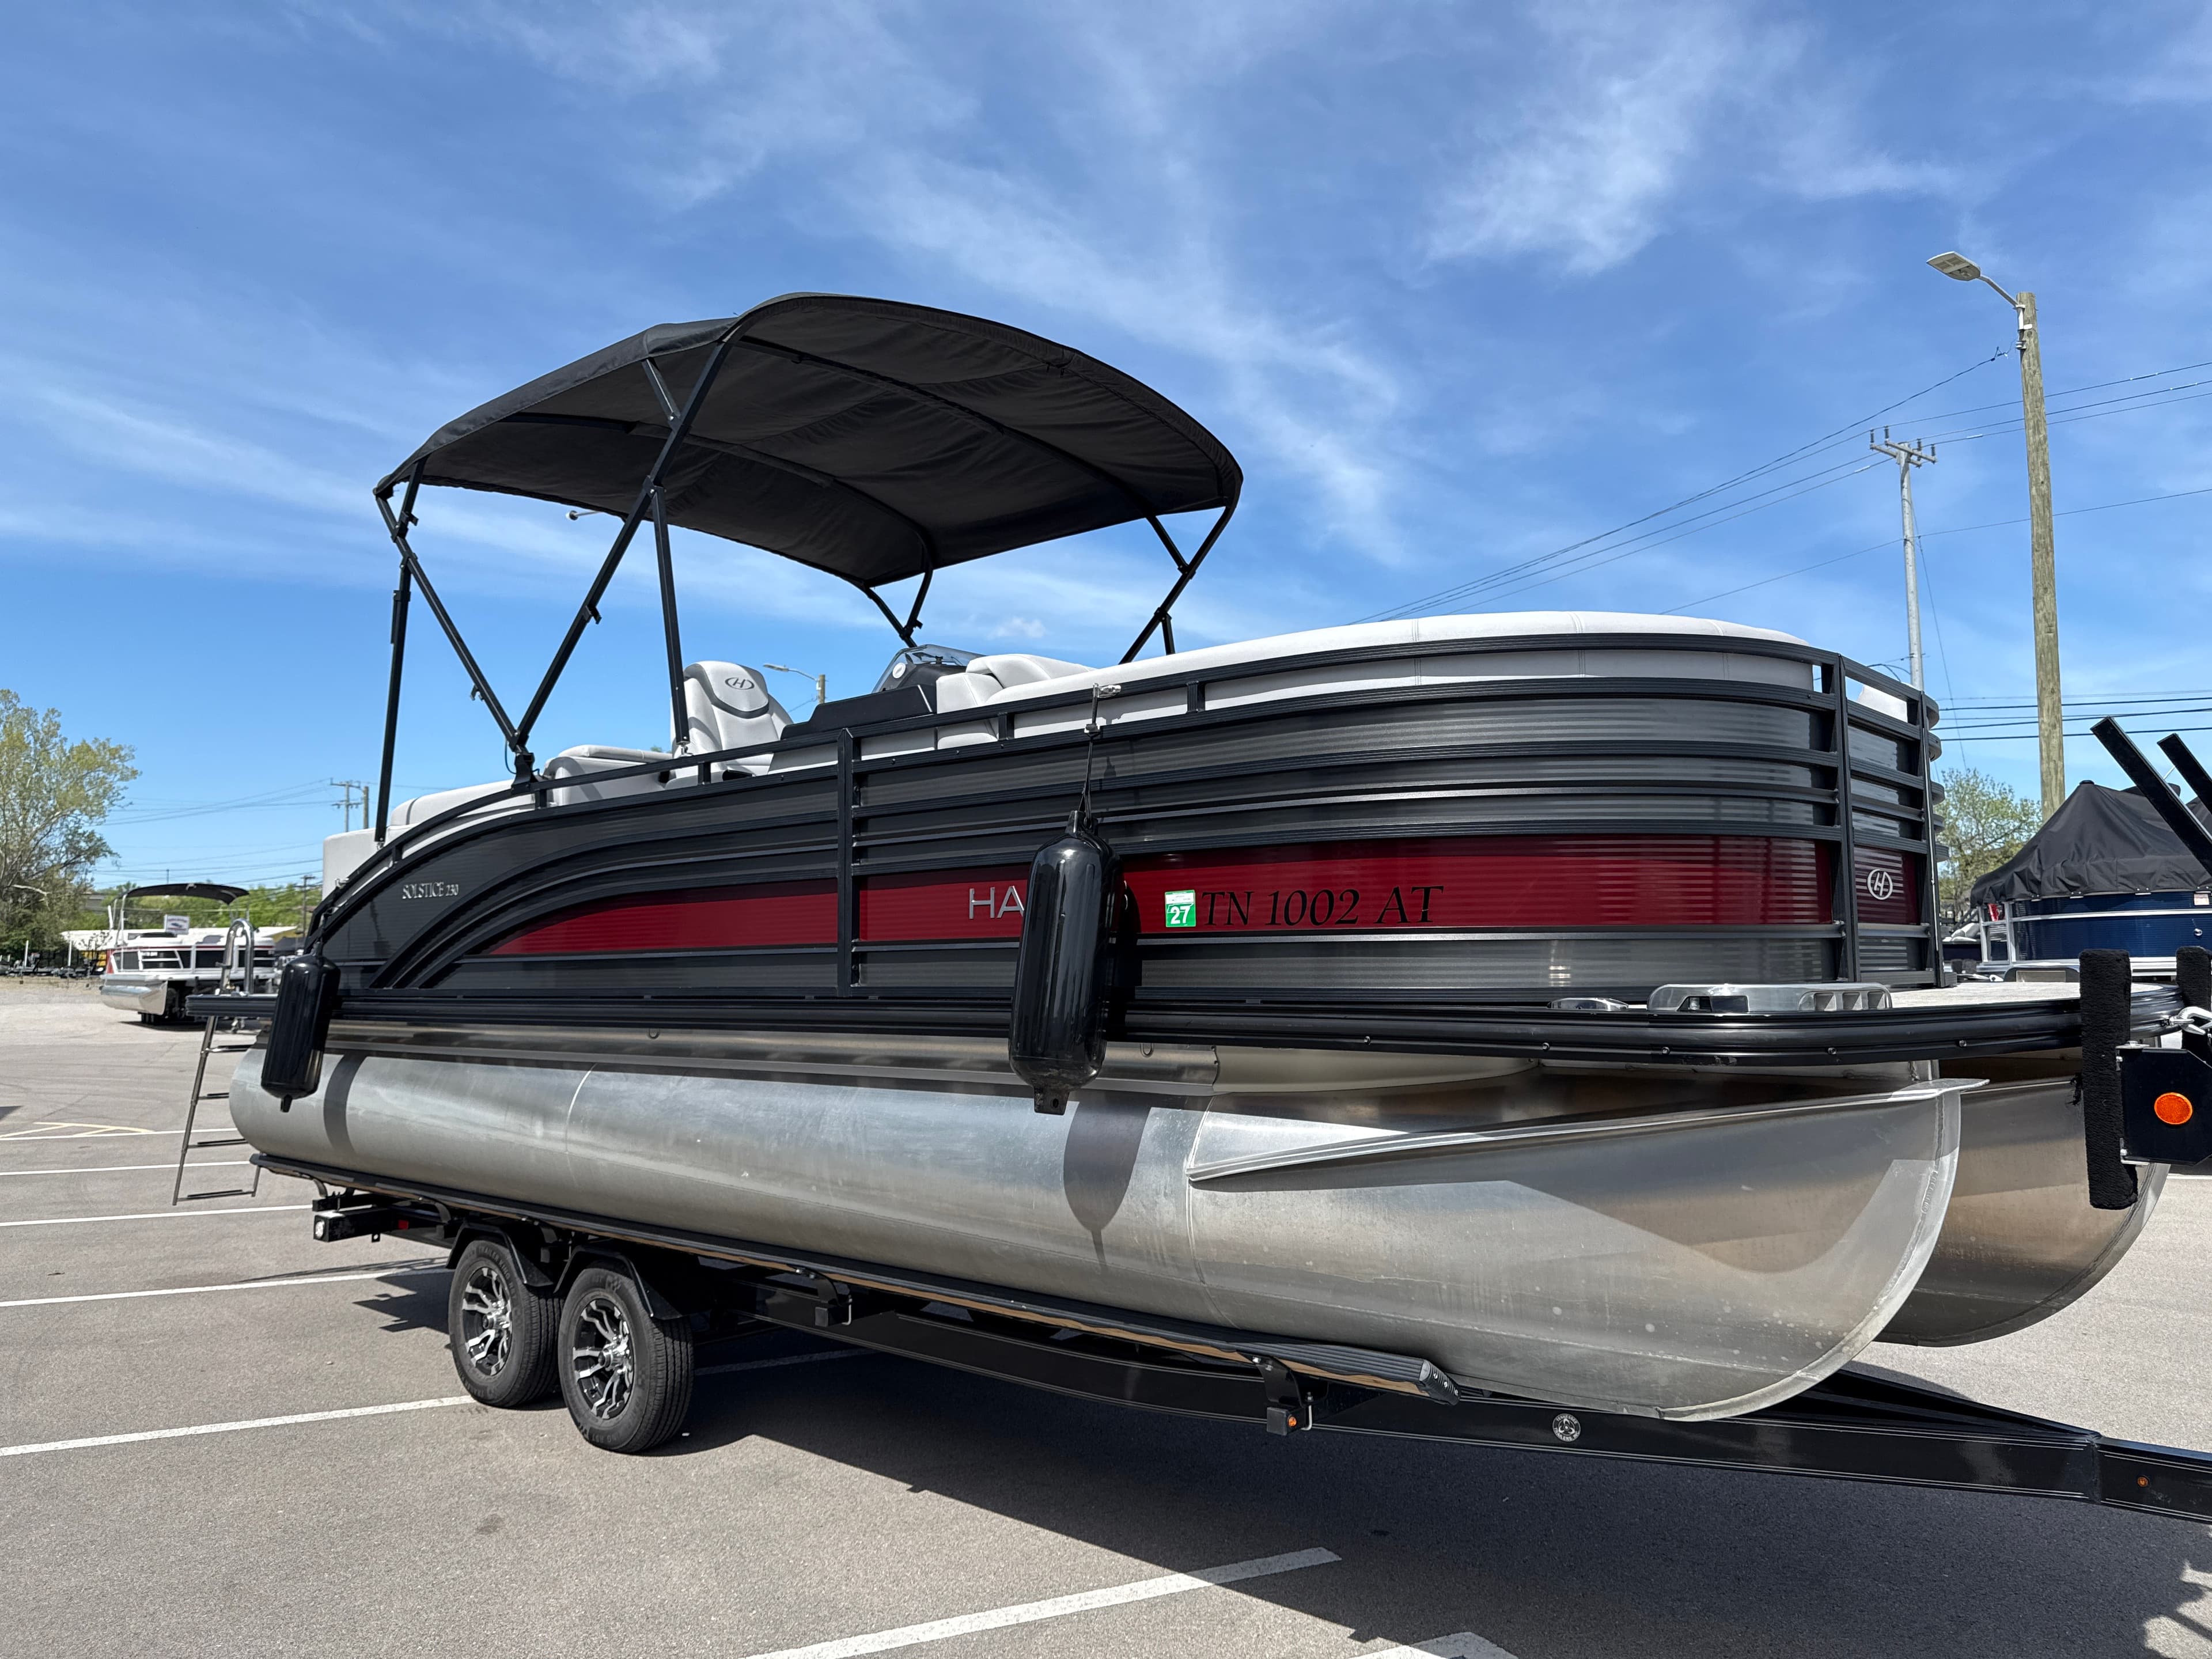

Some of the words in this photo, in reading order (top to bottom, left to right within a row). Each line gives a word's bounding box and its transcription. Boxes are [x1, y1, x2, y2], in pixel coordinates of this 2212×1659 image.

[402, 881, 444, 899] SOLSTICE
[446, 884, 459, 896] 230
[1202, 891, 1255, 926] TN
[1265, 889, 1360, 926] 1002
[1374, 885, 1444, 923] AT
[1170, 906, 1191, 925] 27
